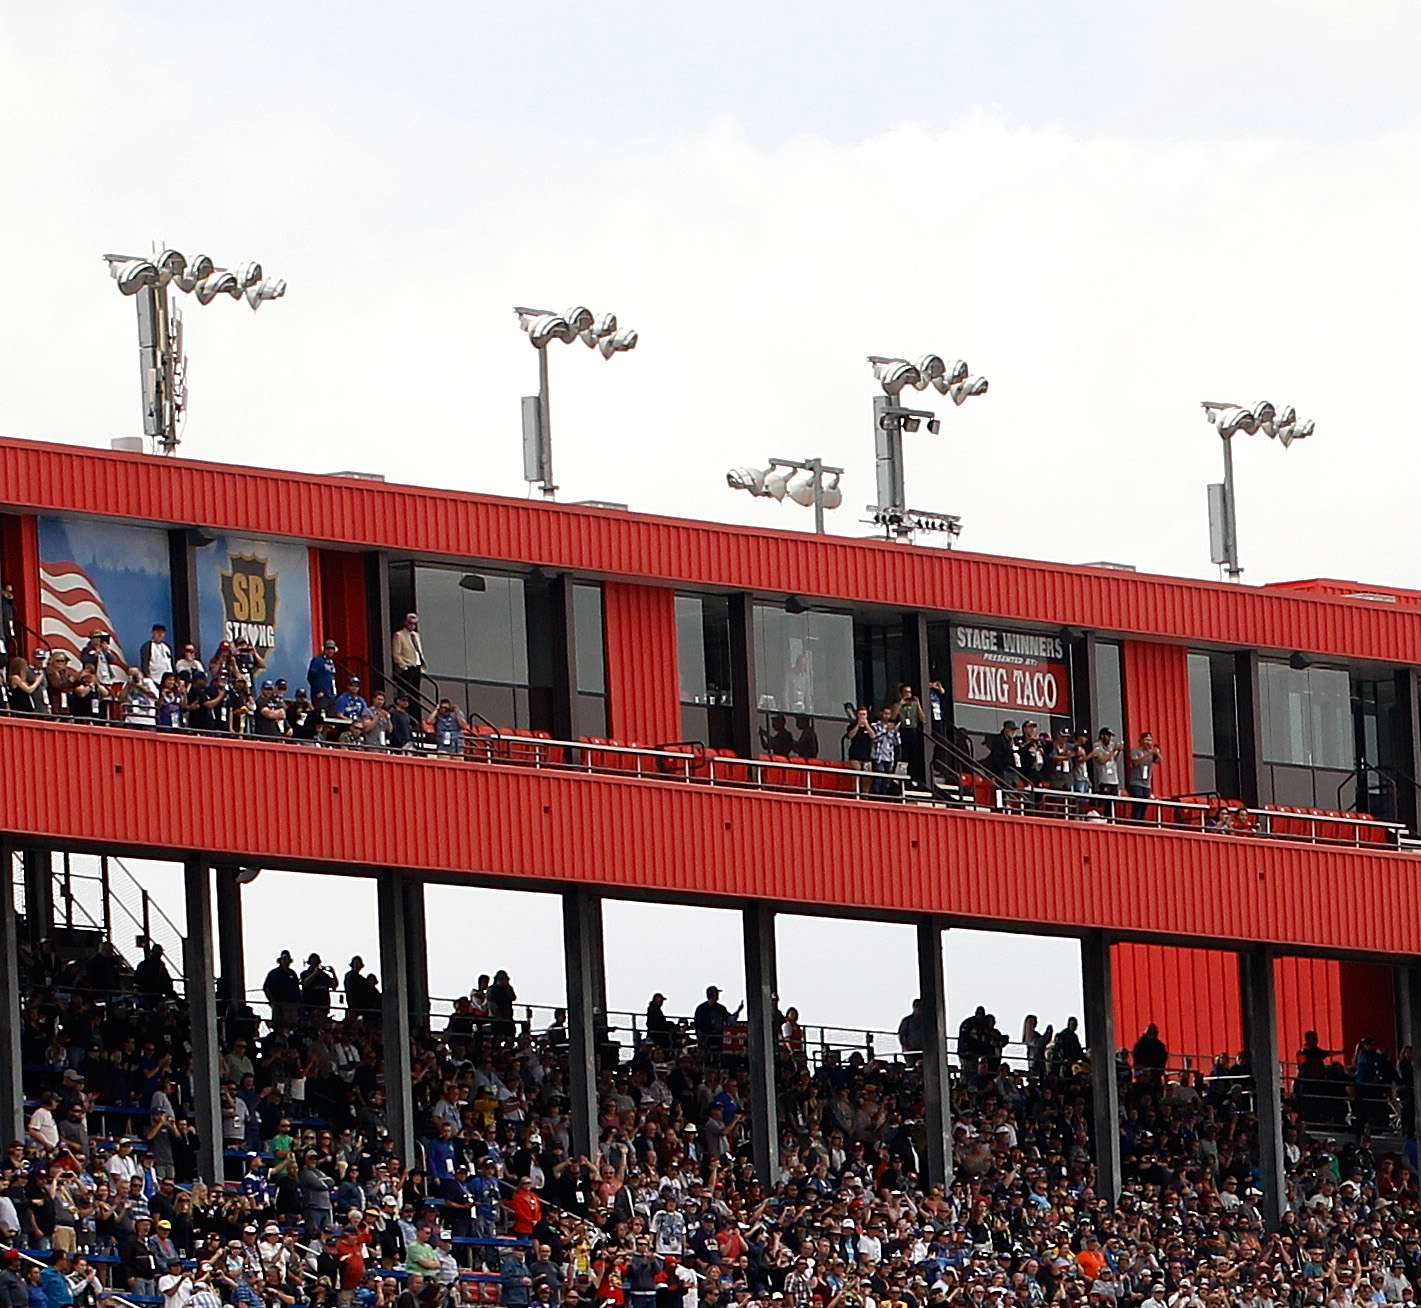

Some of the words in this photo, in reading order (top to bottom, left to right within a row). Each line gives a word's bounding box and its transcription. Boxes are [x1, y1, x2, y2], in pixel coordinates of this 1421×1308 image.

[232, 572, 266, 622] SB
[957, 626, 997, 651] STAGE
[1003, 632, 1063, 659] WINNERS
[983, 653, 1023, 664] PRESENTED
[967, 665, 1009, 703] KING
[1013, 669, 1057, 709] TACO
